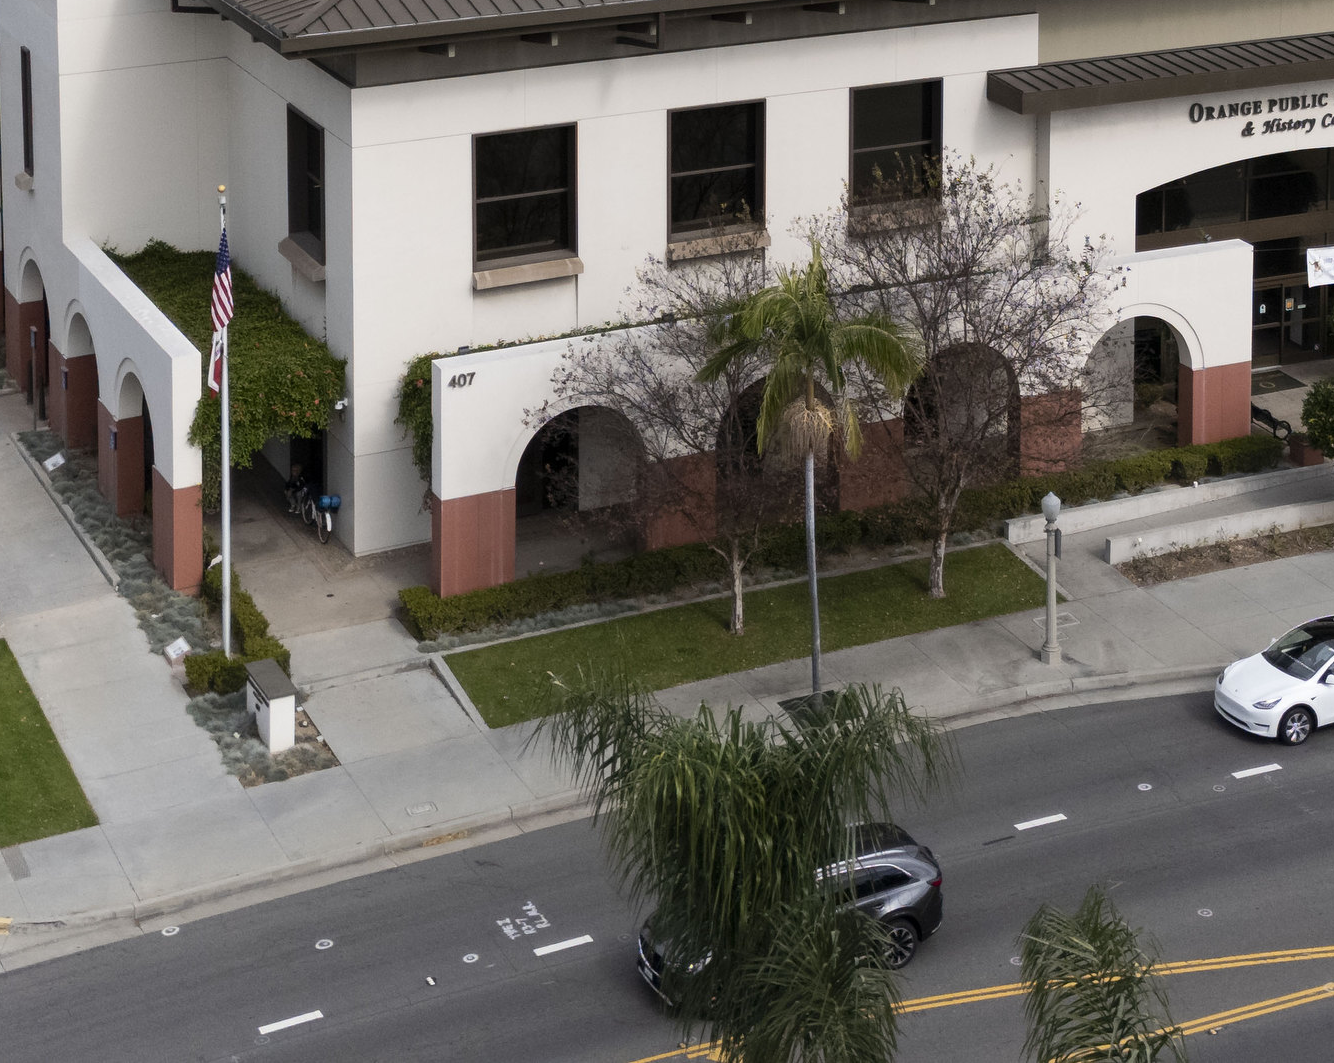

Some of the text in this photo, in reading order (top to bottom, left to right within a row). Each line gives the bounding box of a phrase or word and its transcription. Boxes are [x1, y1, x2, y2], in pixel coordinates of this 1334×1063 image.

[1267, 93, 1329, 114] PUBLIC
[1241, 121, 1255, 138] &
[1261, 117, 1317, 134] History
[448, 372, 476, 389] 407
